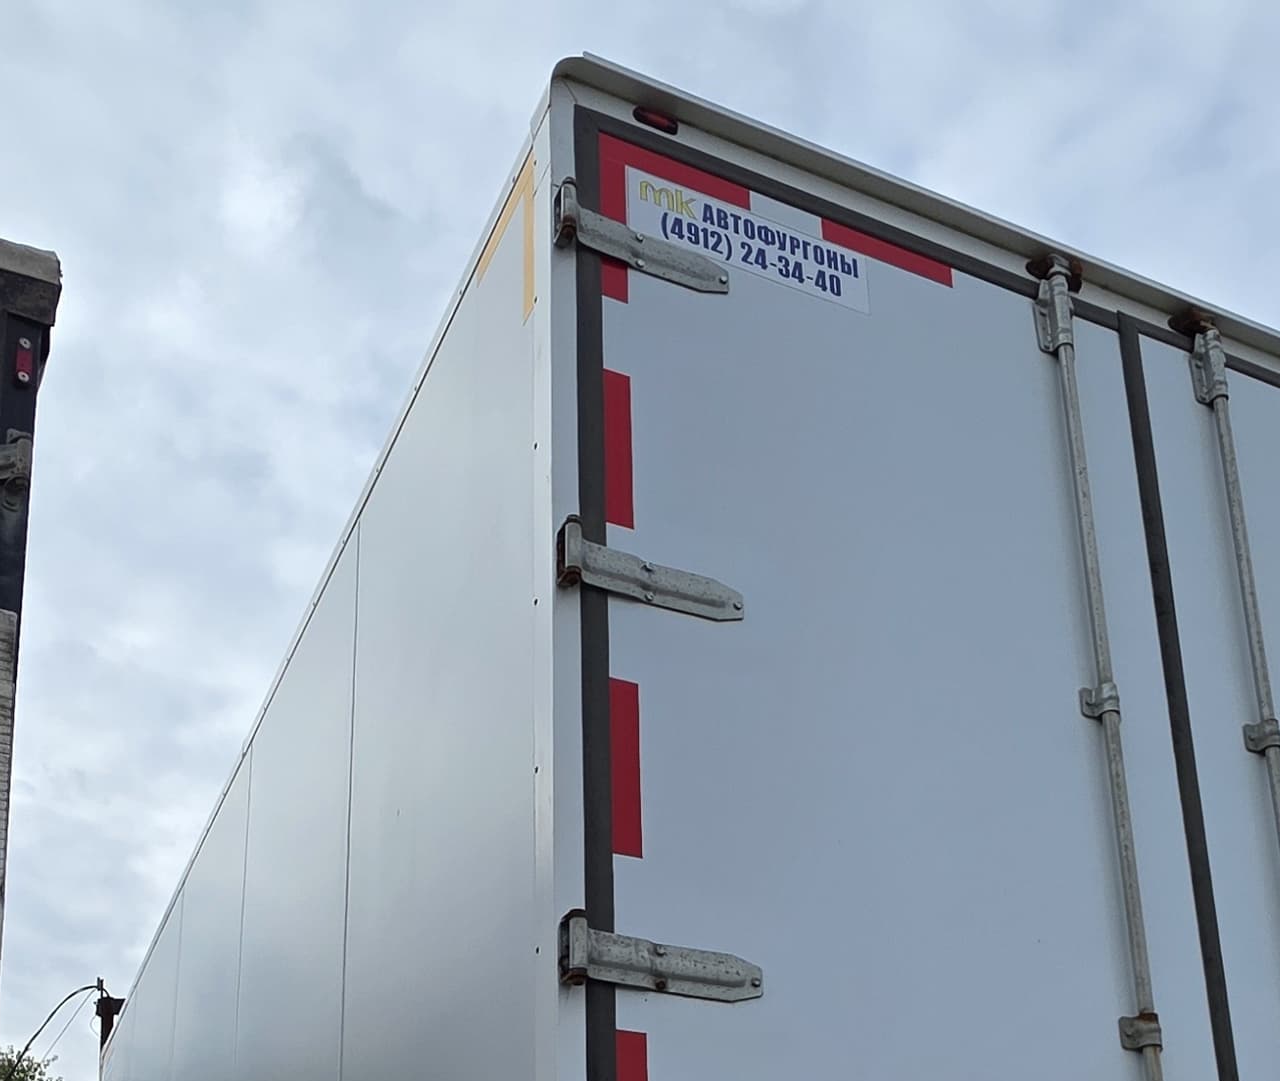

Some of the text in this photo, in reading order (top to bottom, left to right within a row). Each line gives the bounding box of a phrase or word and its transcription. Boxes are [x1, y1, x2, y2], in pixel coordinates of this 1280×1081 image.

[661, 211, 842, 297] (4912) 24-34-40
[702, 203, 858, 279] АВТОФУРГОНЫ
